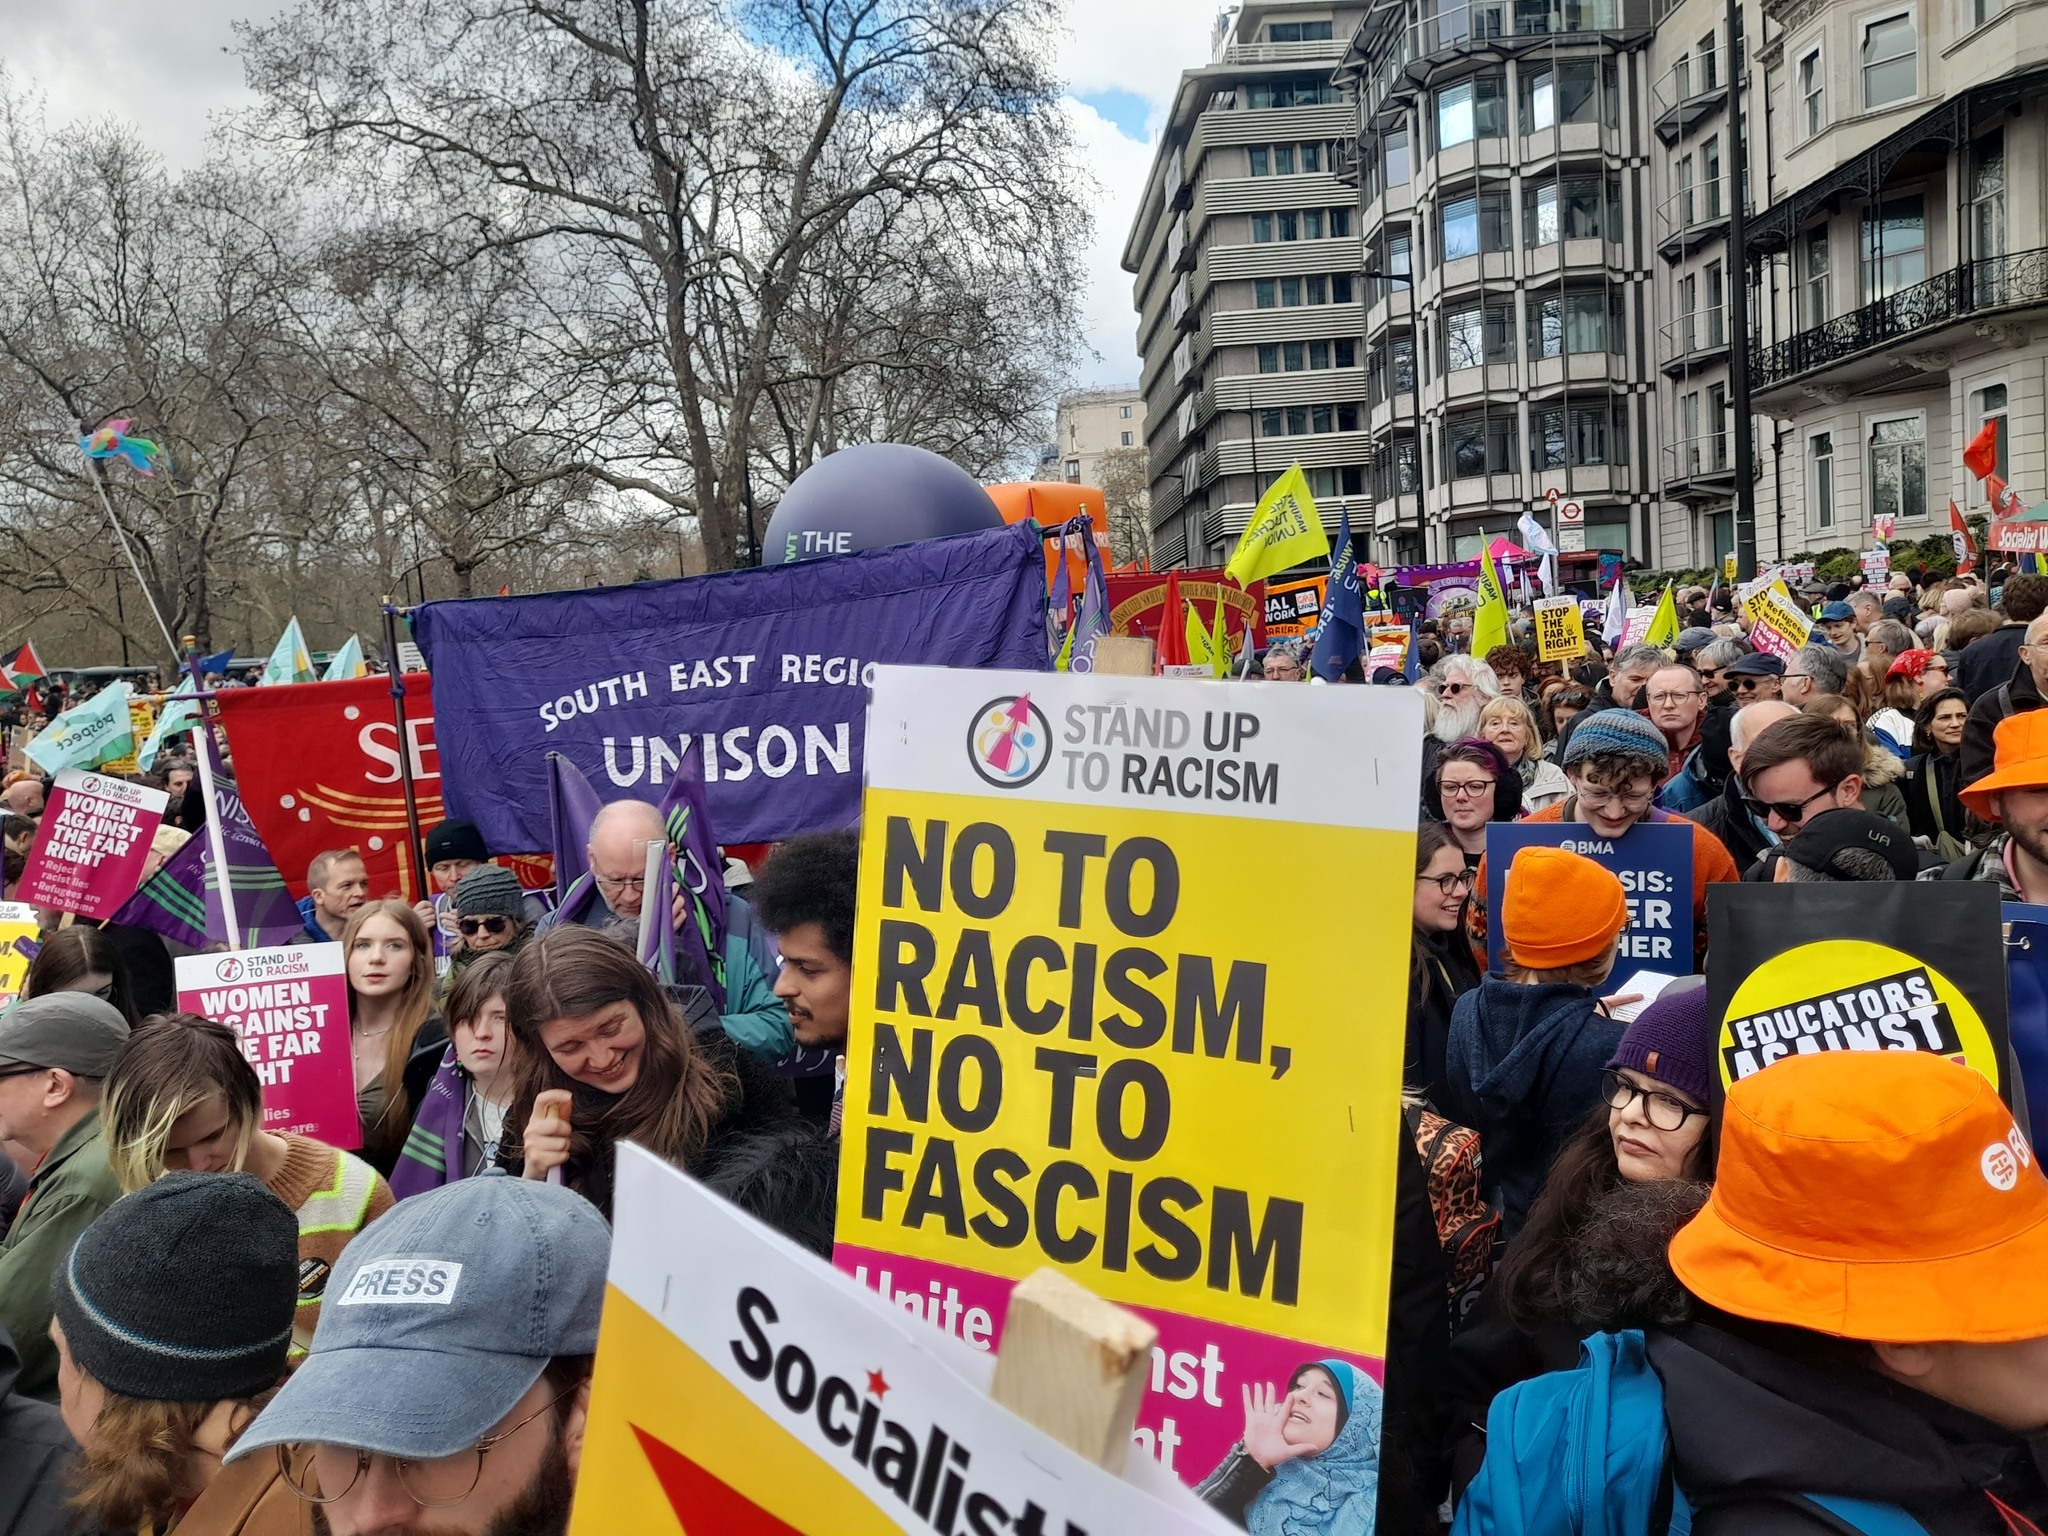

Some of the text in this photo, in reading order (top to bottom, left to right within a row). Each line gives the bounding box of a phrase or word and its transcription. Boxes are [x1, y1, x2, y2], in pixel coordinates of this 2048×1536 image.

[1548, 489, 1559, 500] A
[802, 531, 852, 553] THE
[1998, 525, 2039, 549] Socialist
[1297, 593, 1315, 604] GMB
[1541, 606, 1570, 620] STOP
[1542, 618, 1564, 630] THE
[1767, 600, 1807, 639] Refugees
[1544, 628, 1565, 640] FAR
[1758, 620, 1780, 643] Stop
[1763, 610, 1801, 647] welcome
[1545, 636, 1578, 650] RIGHT
[539, 671, 649, 732] SOUTH
[670, 655, 757, 692] EAST
[1063, 704, 1261, 753] STAND UP
[603, 722, 851, 788] UNISON
[103, 781, 142, 797] STAND UP
[1061, 750, 1280, 805] TO RACISM
[64, 791, 138, 824] WOMEN
[101, 788, 142, 804] TO RACISM
[56, 809, 143, 843] AGAINST
[1868, 829, 1891, 847] UA
[53, 824, 130, 858] THE FAR
[1577, 840, 1615, 855] BMA
[44, 840, 106, 868] RIGHT
[45, 860, 78, 876] Reject
[882, 816, 1180, 938] NO TO
[37, 880, 101, 904] Refugees are
[41, 872, 90, 890] racist lies
[34, 892, 96, 913] not to blame
[247, 952, 304, 968] STAND UP
[248, 963, 310, 978] TO RACISM
[200, 981, 311, 1016] WOMEN
[875, 918, 1292, 1081] RACISM,
[1735, 976, 1933, 1050] EDUCATORS
[267, 1031, 322, 1060] FAR
[867, 1023, 1171, 1162] NO TO
[263, 1107, 291, 1122] lies
[290, 1122, 315, 1135] are
[860, 1127, 1304, 1308] FASCISM
[349, 1268, 449, 1298] PRESS
